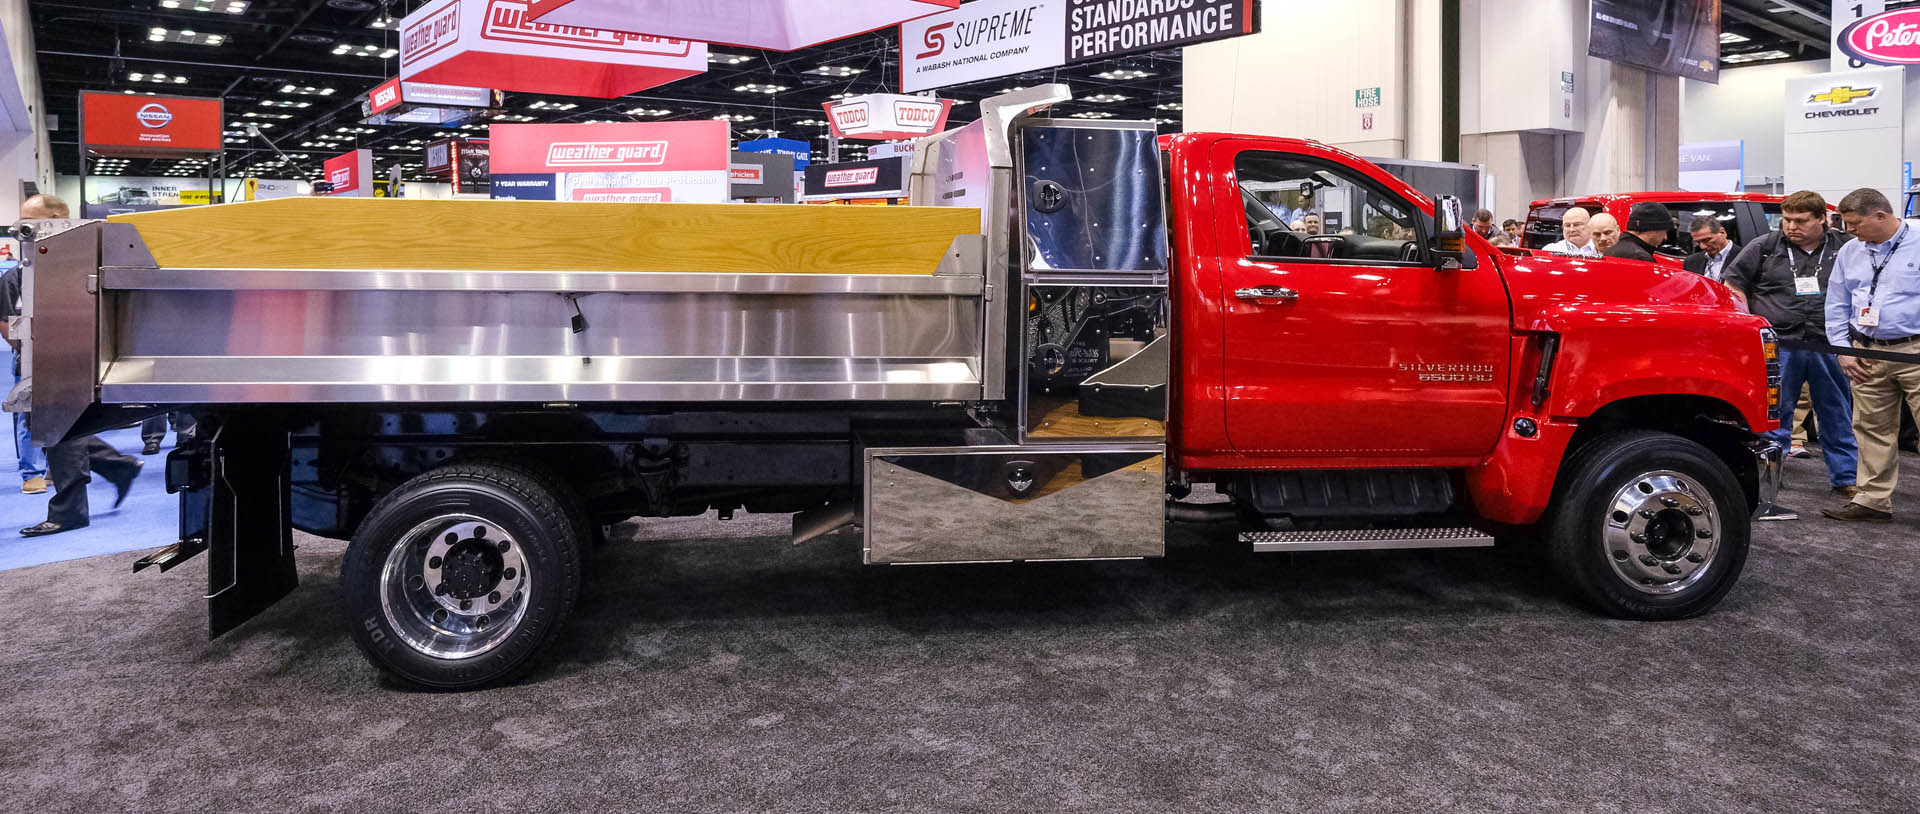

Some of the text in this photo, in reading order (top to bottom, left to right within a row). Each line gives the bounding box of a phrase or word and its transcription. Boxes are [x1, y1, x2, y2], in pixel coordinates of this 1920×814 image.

[954, 6, 1037, 50] SUPREME
[1071, 3, 1233, 59] PERFORMANCE
[916, 45, 1030, 74] A WABASH NATIONAL COMPANY
[1359, 88, 1377, 98] FIRE
[1357, 96, 1379, 107] HOSE
[837, 108, 866, 124] TODCO
[899, 107, 935, 122] TODCO
[1805, 107, 1879, 119] CHEVROLET
[551, 143, 614, 159] weather
[796, 152, 809, 160] GATE
[827, 169, 875, 182] weather guard
[1399, 363, 1493, 372] SILVERADO
